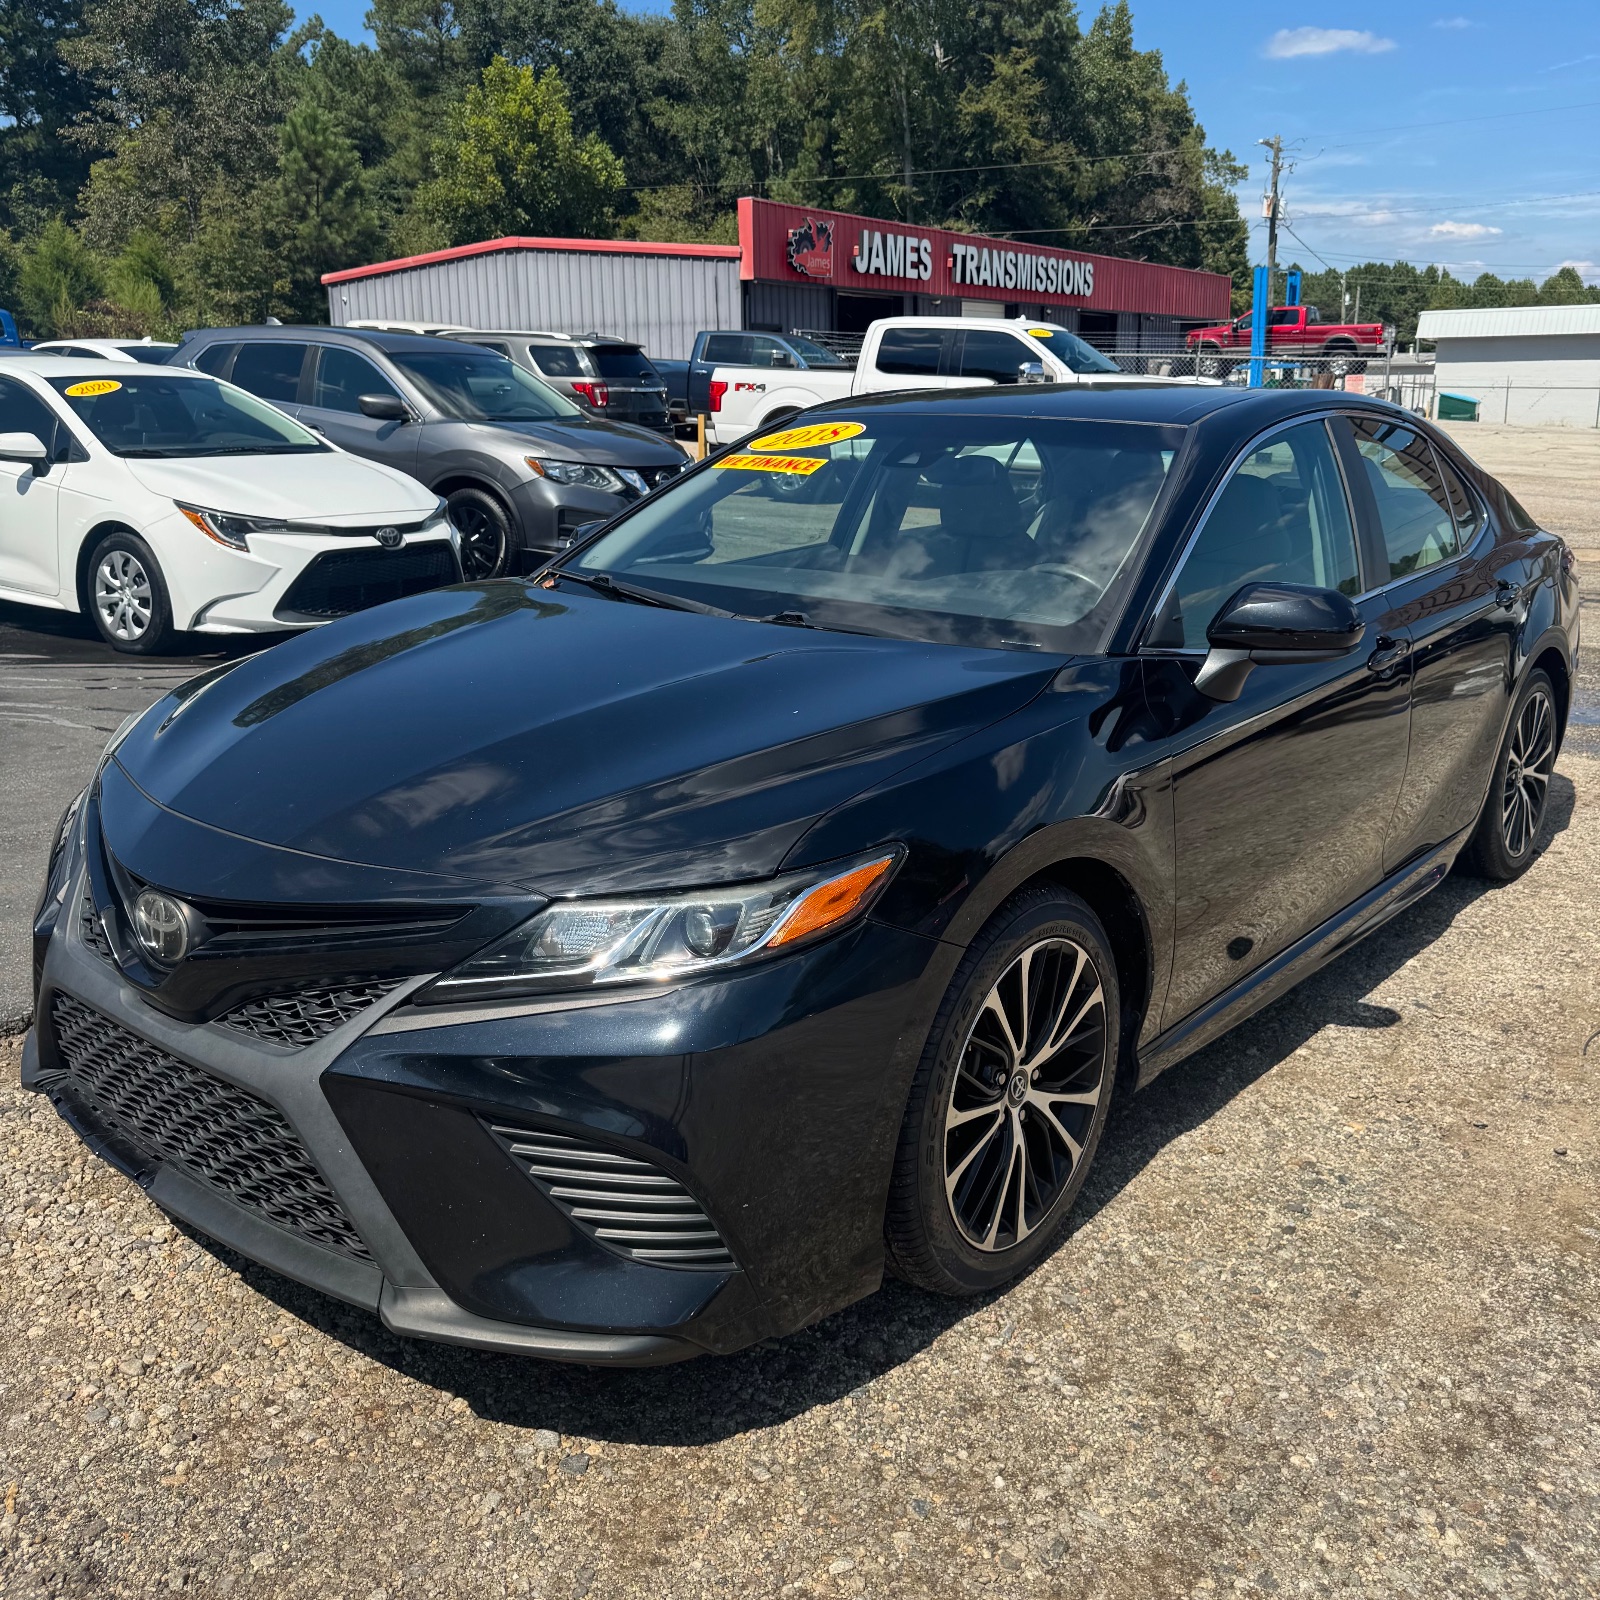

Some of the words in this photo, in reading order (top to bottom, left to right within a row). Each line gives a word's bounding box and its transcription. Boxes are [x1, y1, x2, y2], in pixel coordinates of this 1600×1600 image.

[806, 253, 831, 270] James
[853, 229, 932, 281] JAMES
[951, 243, 1094, 298] TRANSMISSIONS
[76, 382, 112, 395] 2020
[734, 383, 766, 393] FX4
[761, 425, 850, 448] 2018
[718, 456, 743, 467] WE
[744, 457, 820, 471] FINANCE
